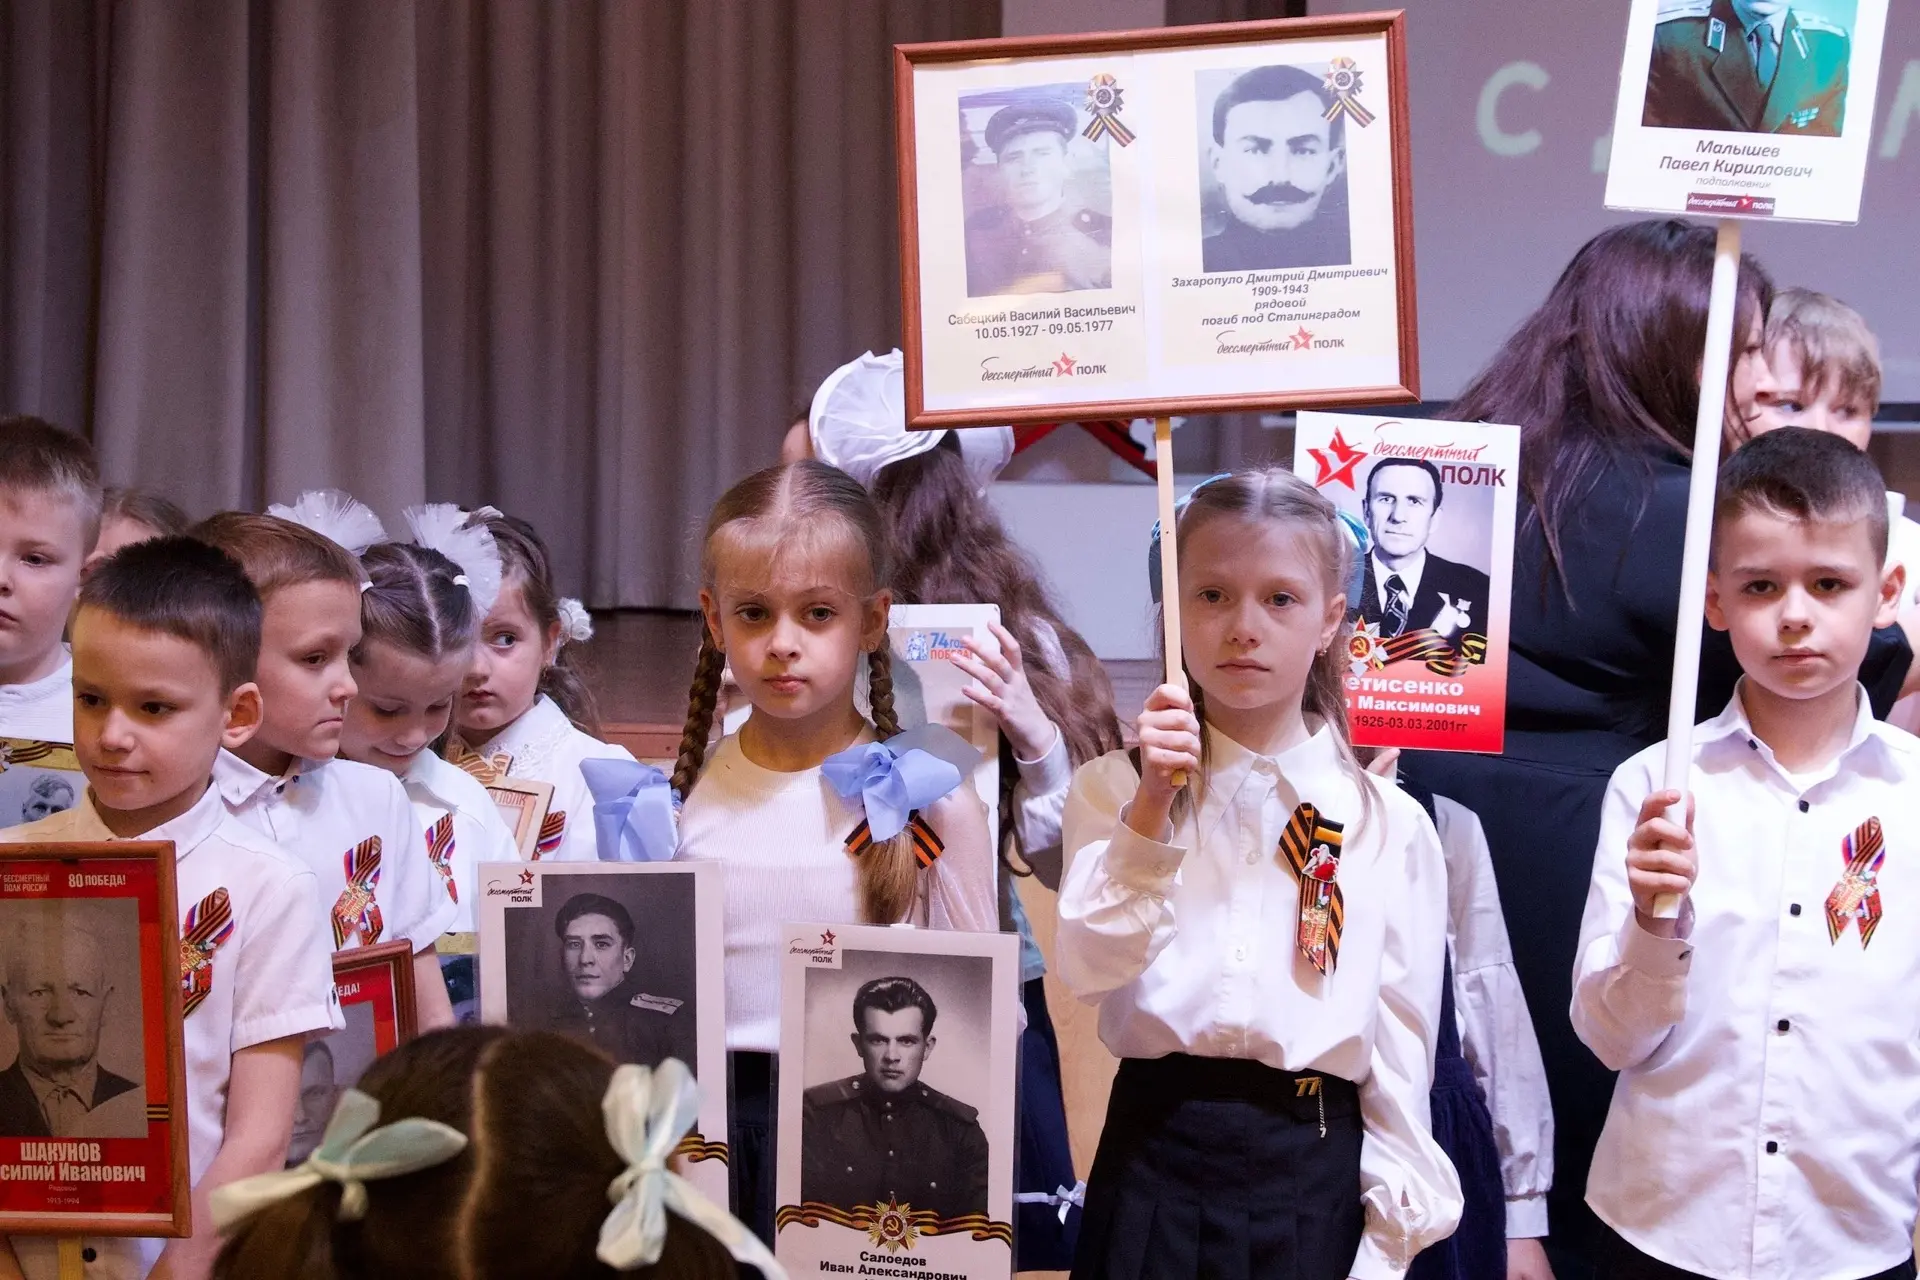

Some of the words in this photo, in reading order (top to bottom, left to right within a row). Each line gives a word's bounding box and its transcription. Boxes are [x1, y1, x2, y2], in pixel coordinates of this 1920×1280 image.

[1696, 139, 1781, 158] Малышев
[1659, 155, 1710, 172] Павел
[1713, 159, 1813, 178] Кириллович
[1695, 176, 1772, 189] подполковник
[1171, 274, 1243, 289] Захаропуло
[1246, 270, 1306, 285] Дмитрий
[1307, 266, 1388, 281] Дмитриевич
[1251, 284, 1309, 297] 1909-1943
[1254, 298, 1307, 311] рядовой
[948, 311, 1007, 326] Сабецкий
[1010, 307, 1061, 322] Василий
[1064, 304, 1136, 320] Васильевич
[1201, 313, 1239, 326] погиб
[1241, 313, 1265, 324] под
[1267, 308, 1361, 325] Сталинградом
[975, 325, 1039, 340] 10.05.1927
[1049, 320, 1114, 335] 09.05.1977
[1215, 329, 1292, 356] бессмертный
[980, 356, 1054, 383] бессмертный
[1373, 421, 1489, 464] бессмертный
[1440, 464, 1506, 487] ПОЛК
[930, 632, 949, 649] 74
[949, 639, 965, 649] го
[930, 649, 973, 660] ПОБА!
[1345, 676, 1464, 697] етисенко
[1358, 695, 1481, 716] Максимович
[499, 790, 525, 806] ПОЛК
[3, 874, 51, 883] БЕССМЕРТНЫЙ
[4, 883, 21, 892] ПОЛК
[22, 883, 48, 892] РОССИИ
[68, 873, 84, 888] 80
[84, 874, 126, 887] ПОБЕДА!
[336, 983, 360, 997] ЕДА!
[20, 1142, 101, 1162] ШАКУНОВ
[0, 1160, 56, 1181] силий
[58, 1162, 146, 1182] Иванович
[859, 1251, 927, 1267] Салоедов
[819, 1261, 854, 1274] Иван
[857, 1264, 968, 1280] Александрович
